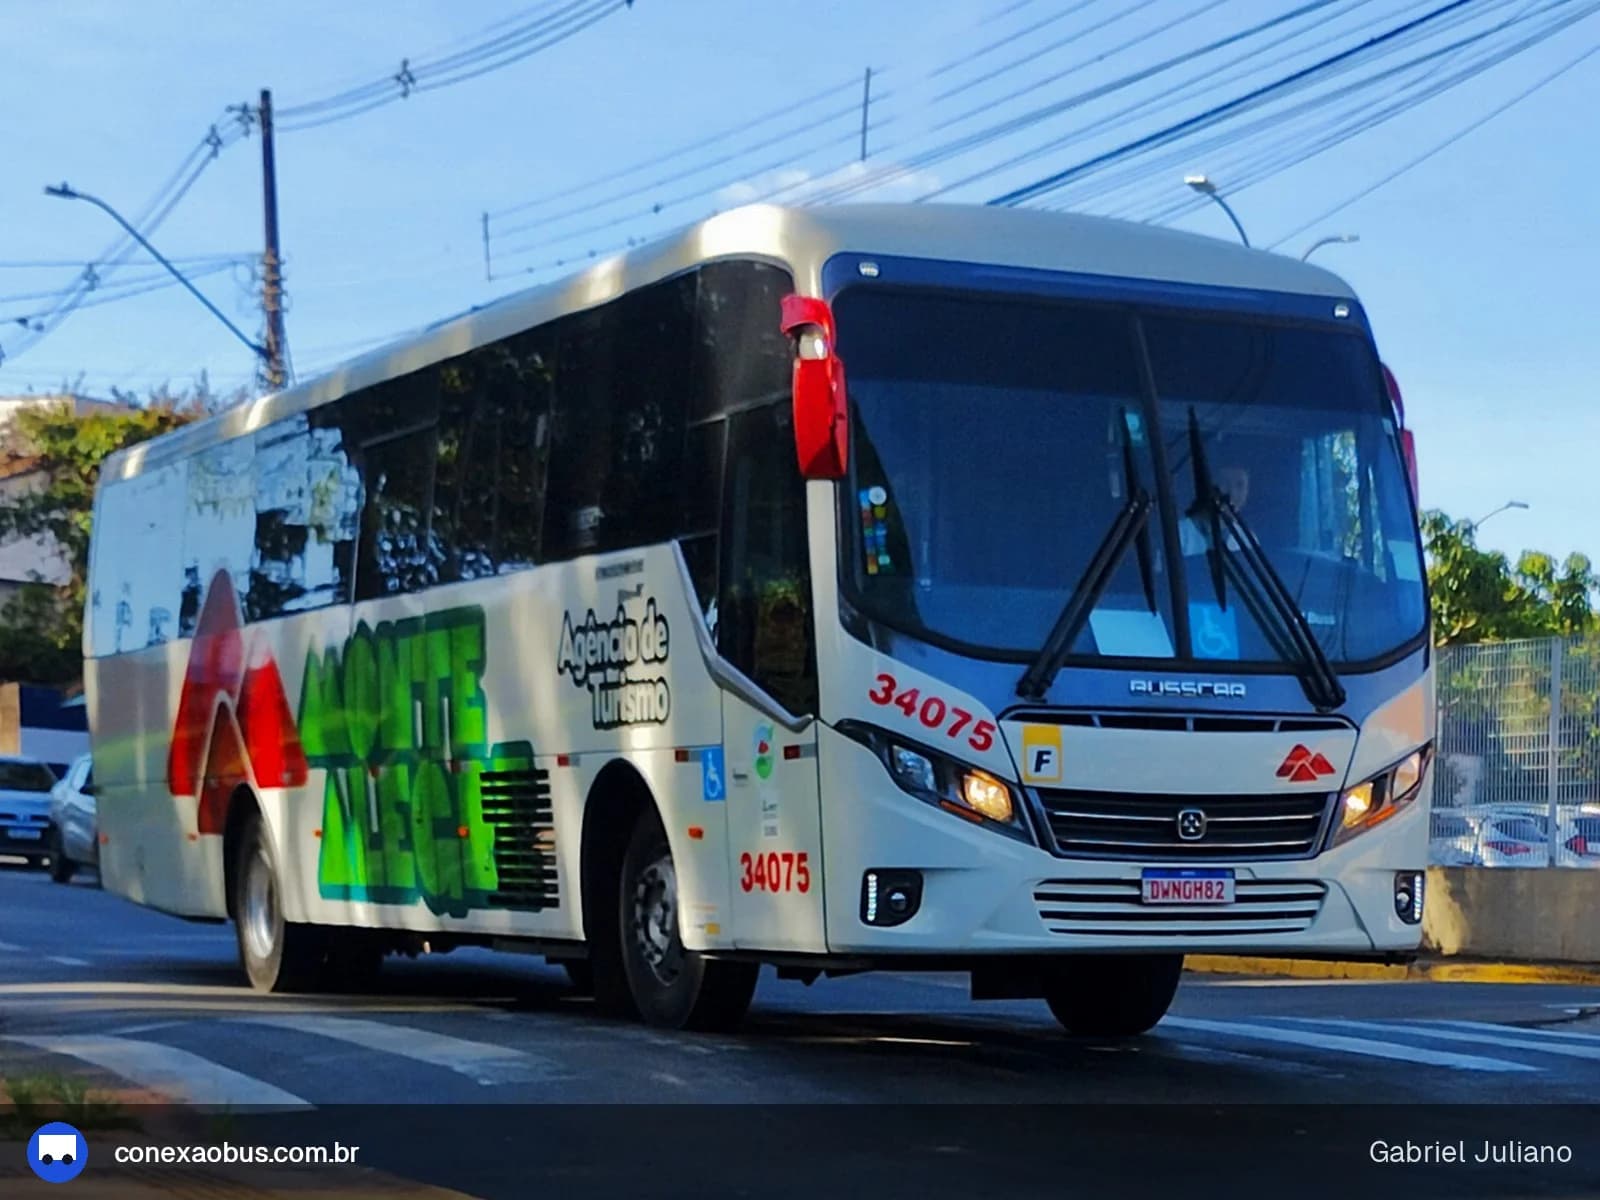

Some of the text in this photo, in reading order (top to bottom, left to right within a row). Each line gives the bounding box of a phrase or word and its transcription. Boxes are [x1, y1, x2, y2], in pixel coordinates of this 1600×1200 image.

[557, 596, 670, 687] Agência de
[587, 668, 670, 730] Turismo
[869, 673, 996, 752] 34075
[1033, 750, 1053, 773] F
[740, 851, 810, 894] 34075
